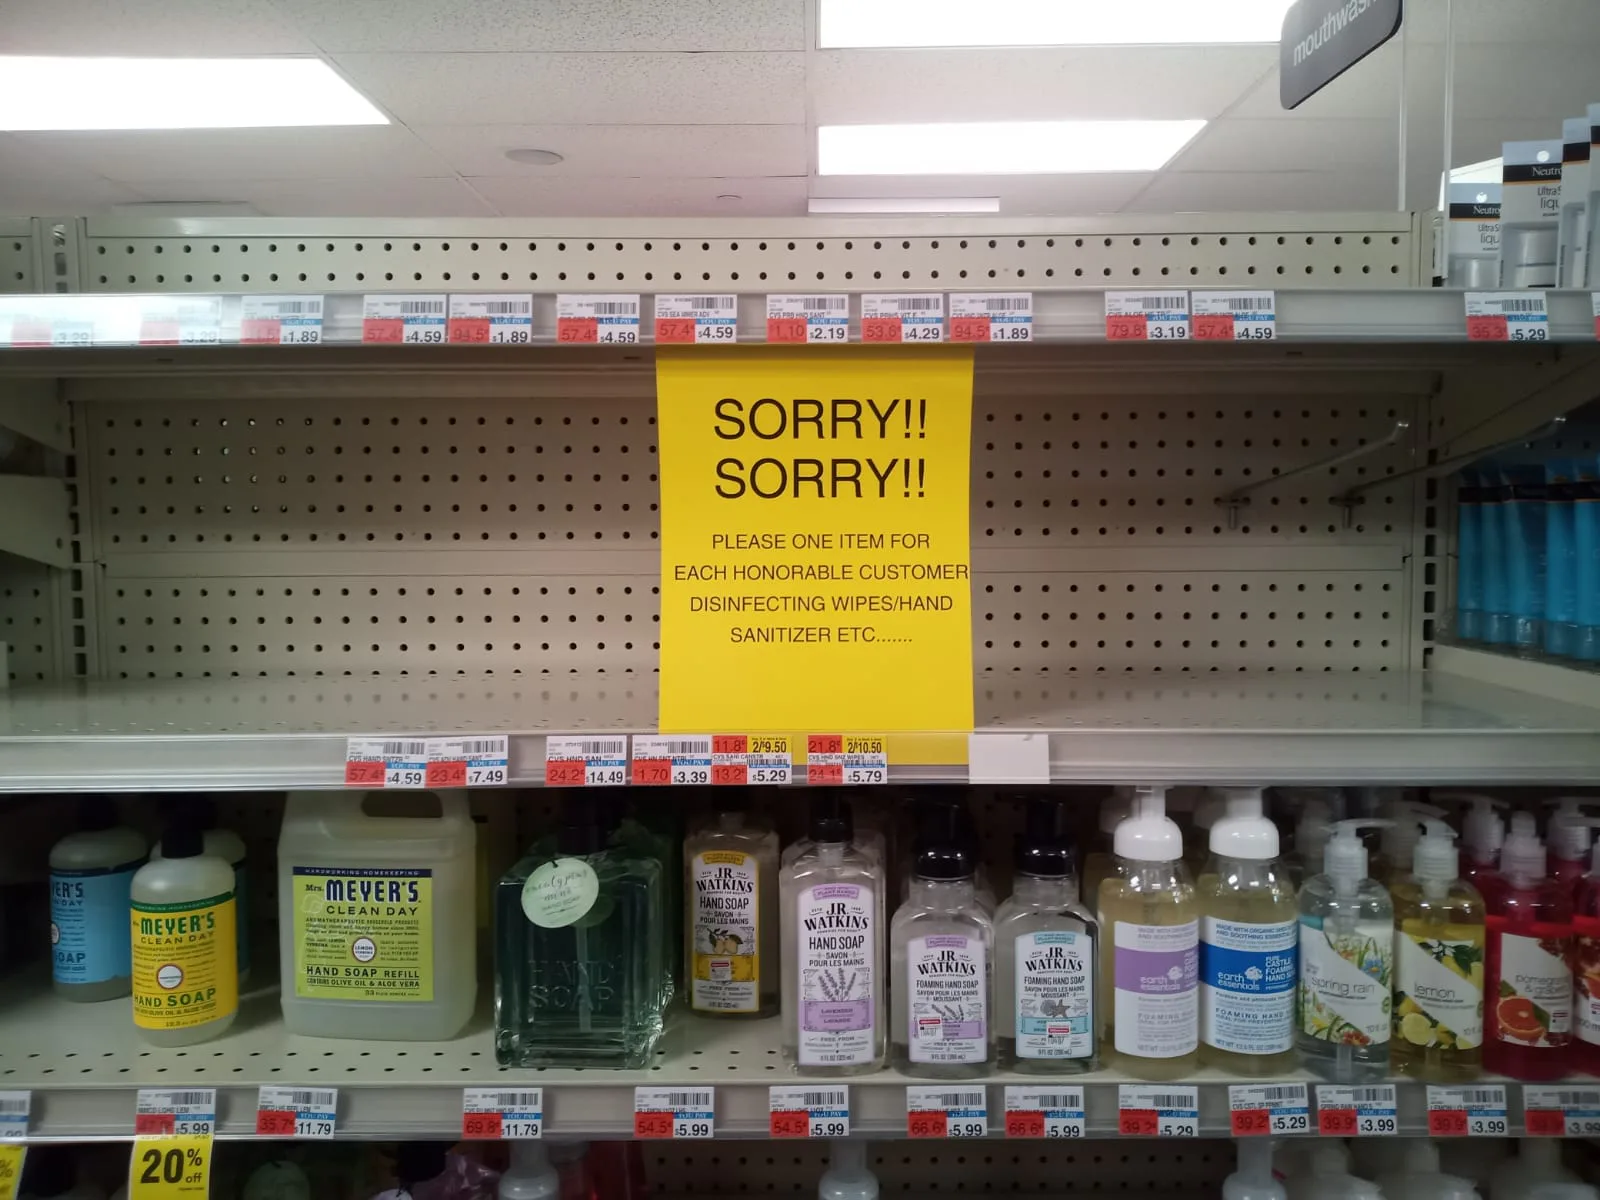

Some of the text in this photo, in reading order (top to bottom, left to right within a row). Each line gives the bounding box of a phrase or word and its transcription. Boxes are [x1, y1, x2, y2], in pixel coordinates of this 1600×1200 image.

[1473, 205, 1501, 215] Neutro
[406, 331, 442, 343] $4.59
[492, 331, 528, 343] $1.89
[600, 331, 636, 343] $4.59
[698, 327, 734, 339] $4.59
[809, 327, 845, 340] $2.19
[904, 327, 940, 340] $4.29
[993, 327, 1029, 339] $1.89
[1150, 326, 1185, 339] $3.19
[1237, 327, 1273, 339] $4.59
[1511, 328, 1546, 340] $5.29
[714, 398, 927, 440] SORRY!!
[715, 458, 926, 499] SORRY!!
[712, 533, 930, 550] PLEASE ONE ITEM FOR
[674, 564, 969, 581] EACH HONORABLE CUSTOMER
[690, 596, 953, 612] DISINFECTING WIPES/HAND
[730, 627, 832, 643] SANITIZER
[387, 772, 422, 785] $4.59
[469, 770, 503, 783] $7.49
[586, 771, 623, 784] $14.49
[673, 770, 708, 784] $3.39
[752, 770, 786, 782] $5.29
[848, 770, 882, 783] $5.79
[305, 879, 419, 903] Mrs. MEYER'S
[696, 878, 754, 893] WATKINS
[700, 896, 749, 910] HAND SOAP
[826, 902, 850, 916] J.R.
[326, 905, 418, 916] CLEAN DAY
[141, 911, 215, 935] MEYER'S
[804, 915, 870, 932] WATKINS
[141, 931, 214, 945] CLEAN DAY
[809, 935, 865, 950] HAND SOAP
[1045, 946, 1066, 958] J.R.
[809, 958, 865, 967] POUR LES MAINS
[917, 961, 977, 976] WATKINS
[1025, 958, 1084, 972] WATKINS
[307, 965, 420, 978] HAND SOAP REFILL
[1217, 971, 1245, 983] earth
[378, 980, 397, 988] ALOE
[916, 979, 979, 989] FOAMING HAND SOAP
[1024, 975, 1086, 985] FOAMING HAND SOAP
[1140, 976, 1168, 984] earth
[1218, 979, 1260, 991] essentials
[1311, 976, 1350, 996] spring
[1353, 983, 1376, 994] rain
[167, 987, 216, 1007] SOAP
[1414, 981, 1455, 1000] lemon
[528, 985, 614, 1011] SOAP
[1215, 1008, 1259, 1020] FOAMING
[176, 1123, 210, 1135] $5.99
[294, 1122, 332, 1135] $11.79
[674, 1123, 709, 1136] $5.99
[811, 1122, 845, 1136] $5.99
[1273, 1116, 1306, 1130] $5.29
[1361, 1119, 1394, 1132] $3.99
[1471, 1120, 1505, 1133] $3.99
[502, 1124, 539, 1136] $11.79
[948, 1124, 983, 1137] $5.99
[1046, 1125, 1080, 1138] $5.99
[1160, 1125, 1194, 1137] $5.29
[140, 1147, 203, 1184] 20%
[185, 1172, 202, 1184] off
